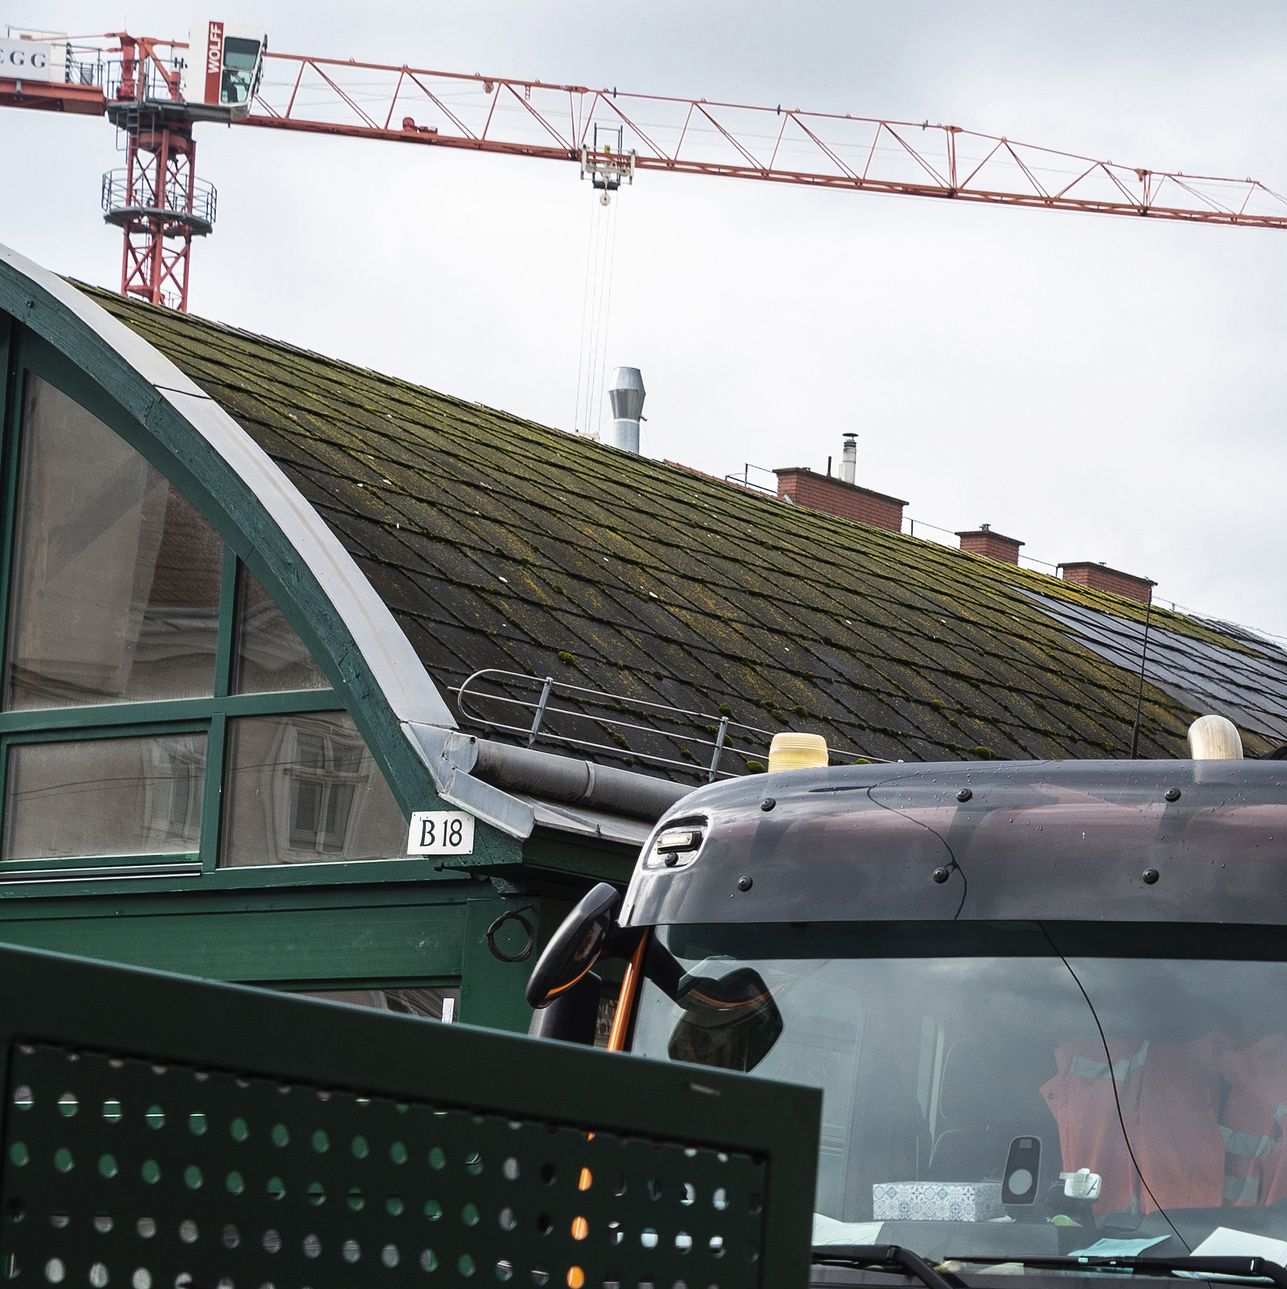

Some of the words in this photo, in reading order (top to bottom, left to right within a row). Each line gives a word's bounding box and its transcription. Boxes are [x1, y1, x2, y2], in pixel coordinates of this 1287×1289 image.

[208, 23, 224, 74] WOLFF
[420, 820, 435, 847] B
[443, 819, 463, 847] 18
